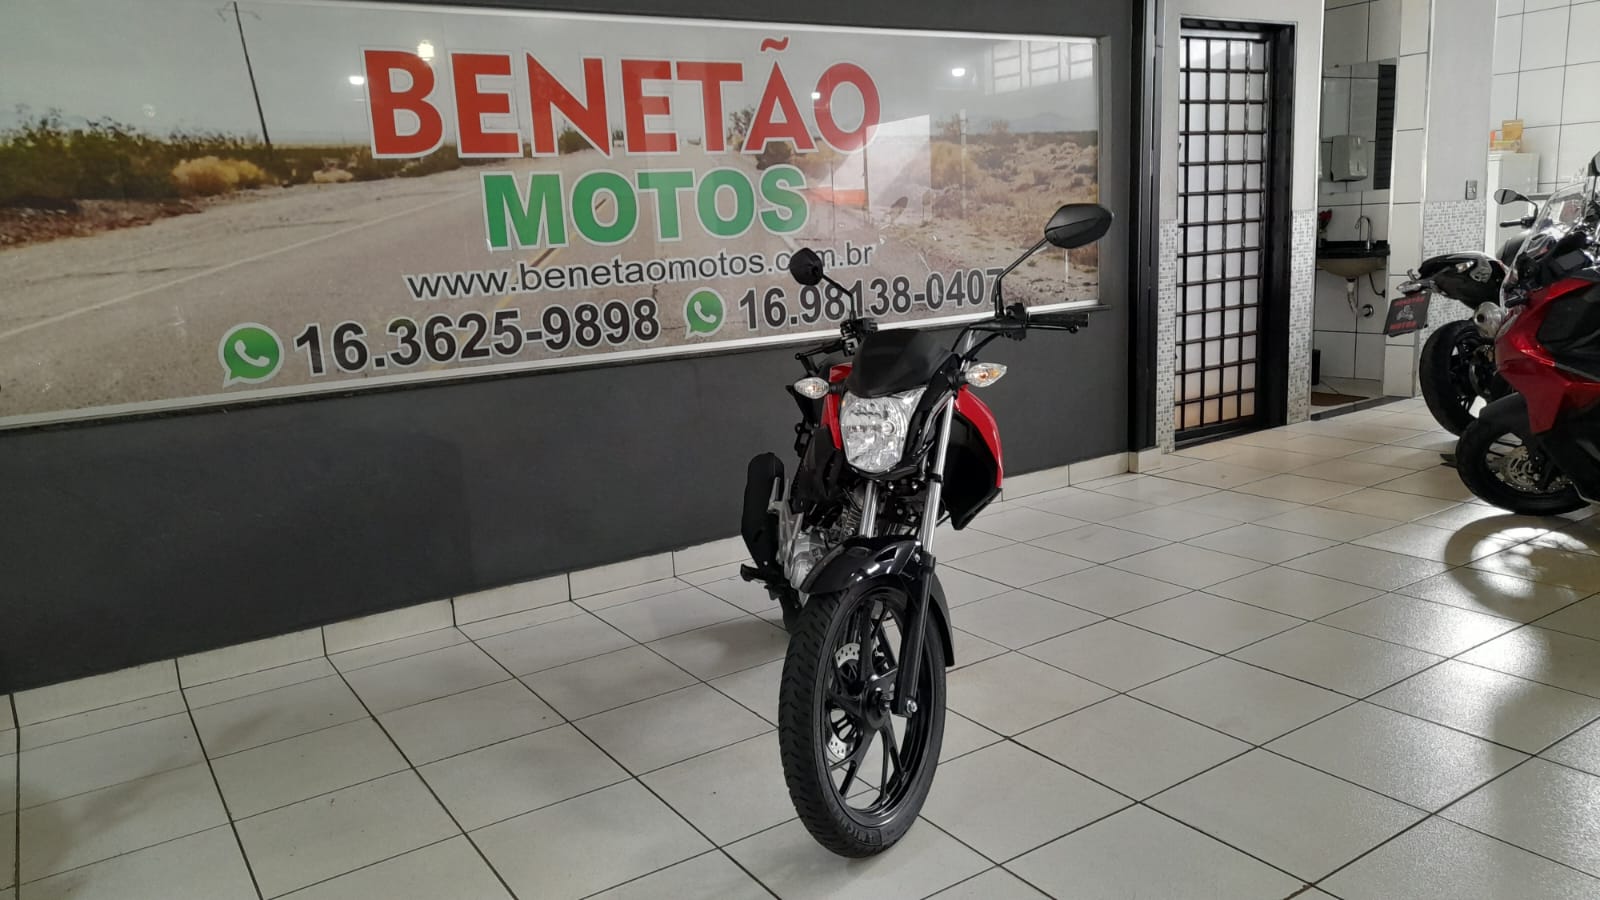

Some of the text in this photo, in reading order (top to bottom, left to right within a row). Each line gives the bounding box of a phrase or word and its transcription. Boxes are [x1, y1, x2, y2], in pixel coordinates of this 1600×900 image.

[364, 37, 880, 156] BENETÃO
[484, 166, 807, 248] MOTOS
[409, 242, 872, 298] www.benetaomotos.cm.br
[740, 268, 1003, 328] 16.98138-0407
[296, 300, 659, 375] 16.3625-9898
